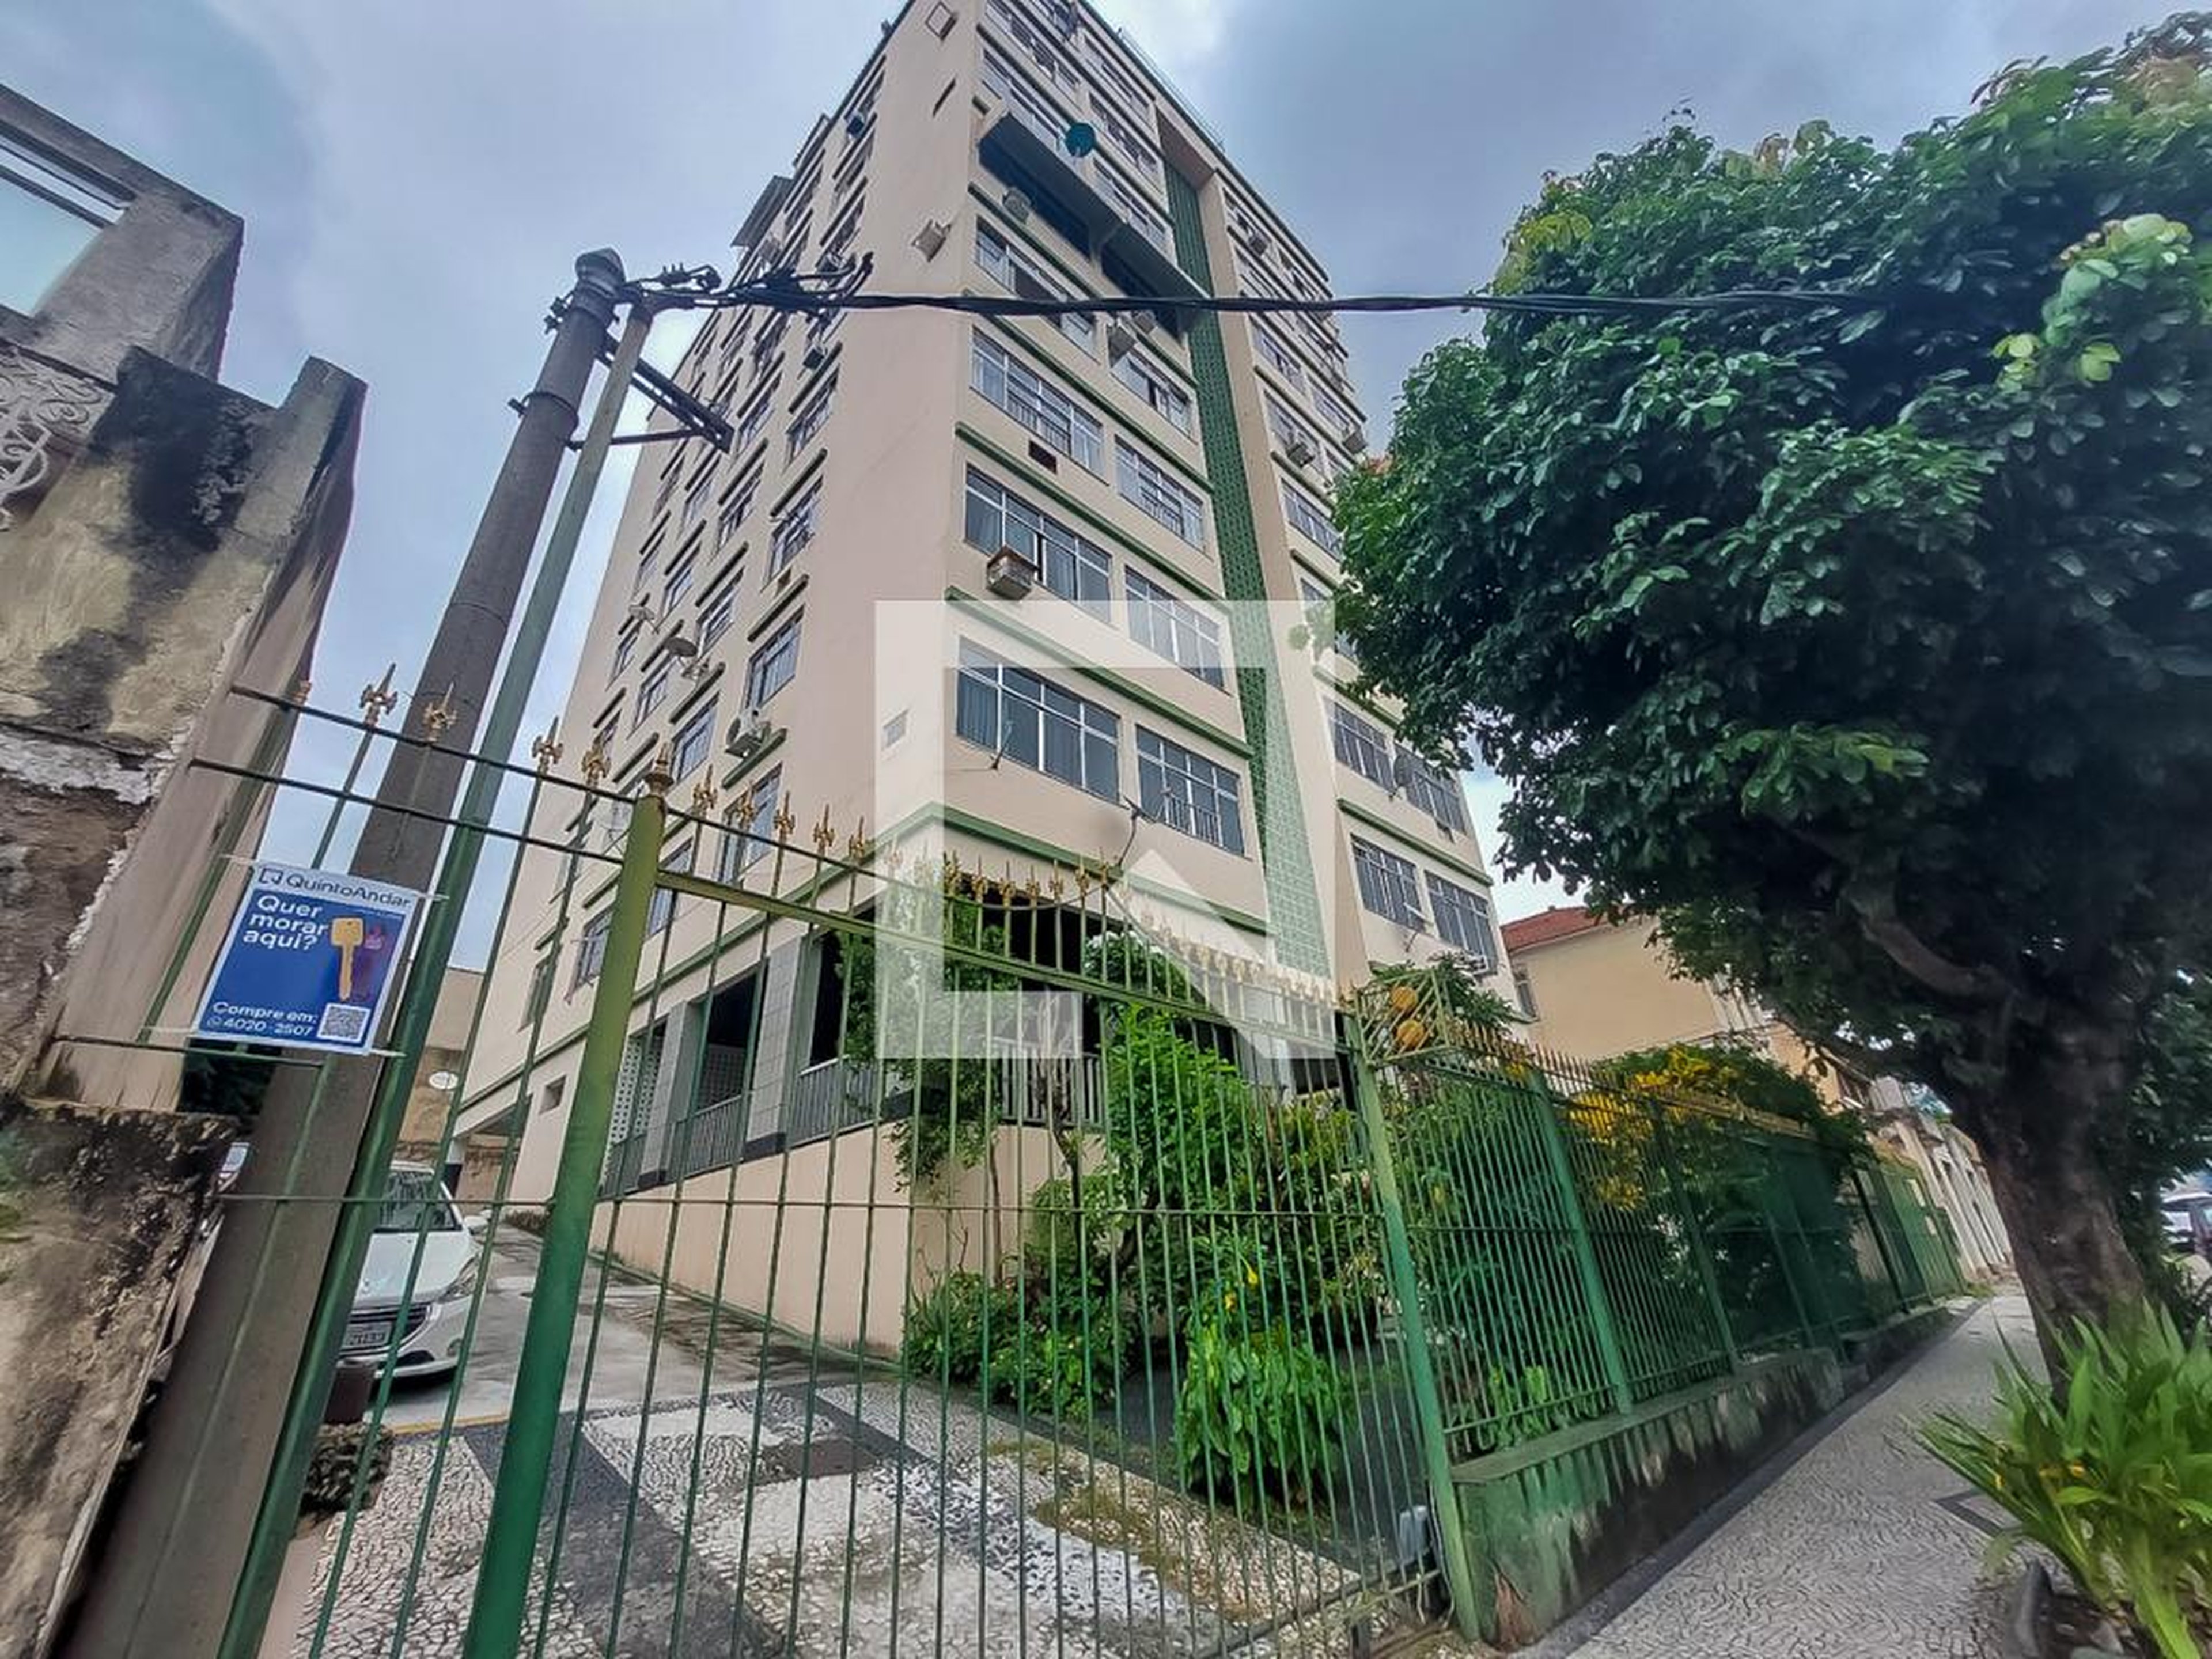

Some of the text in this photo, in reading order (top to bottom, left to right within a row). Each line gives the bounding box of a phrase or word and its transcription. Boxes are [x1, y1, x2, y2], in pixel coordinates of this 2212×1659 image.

[286, 873, 411, 907] QuintoAndar
[257, 895, 323, 918] Quer
[249, 914, 329, 936] morar
[243, 930, 317, 950] aqui?
[213, 1001, 284, 1019] Compre
